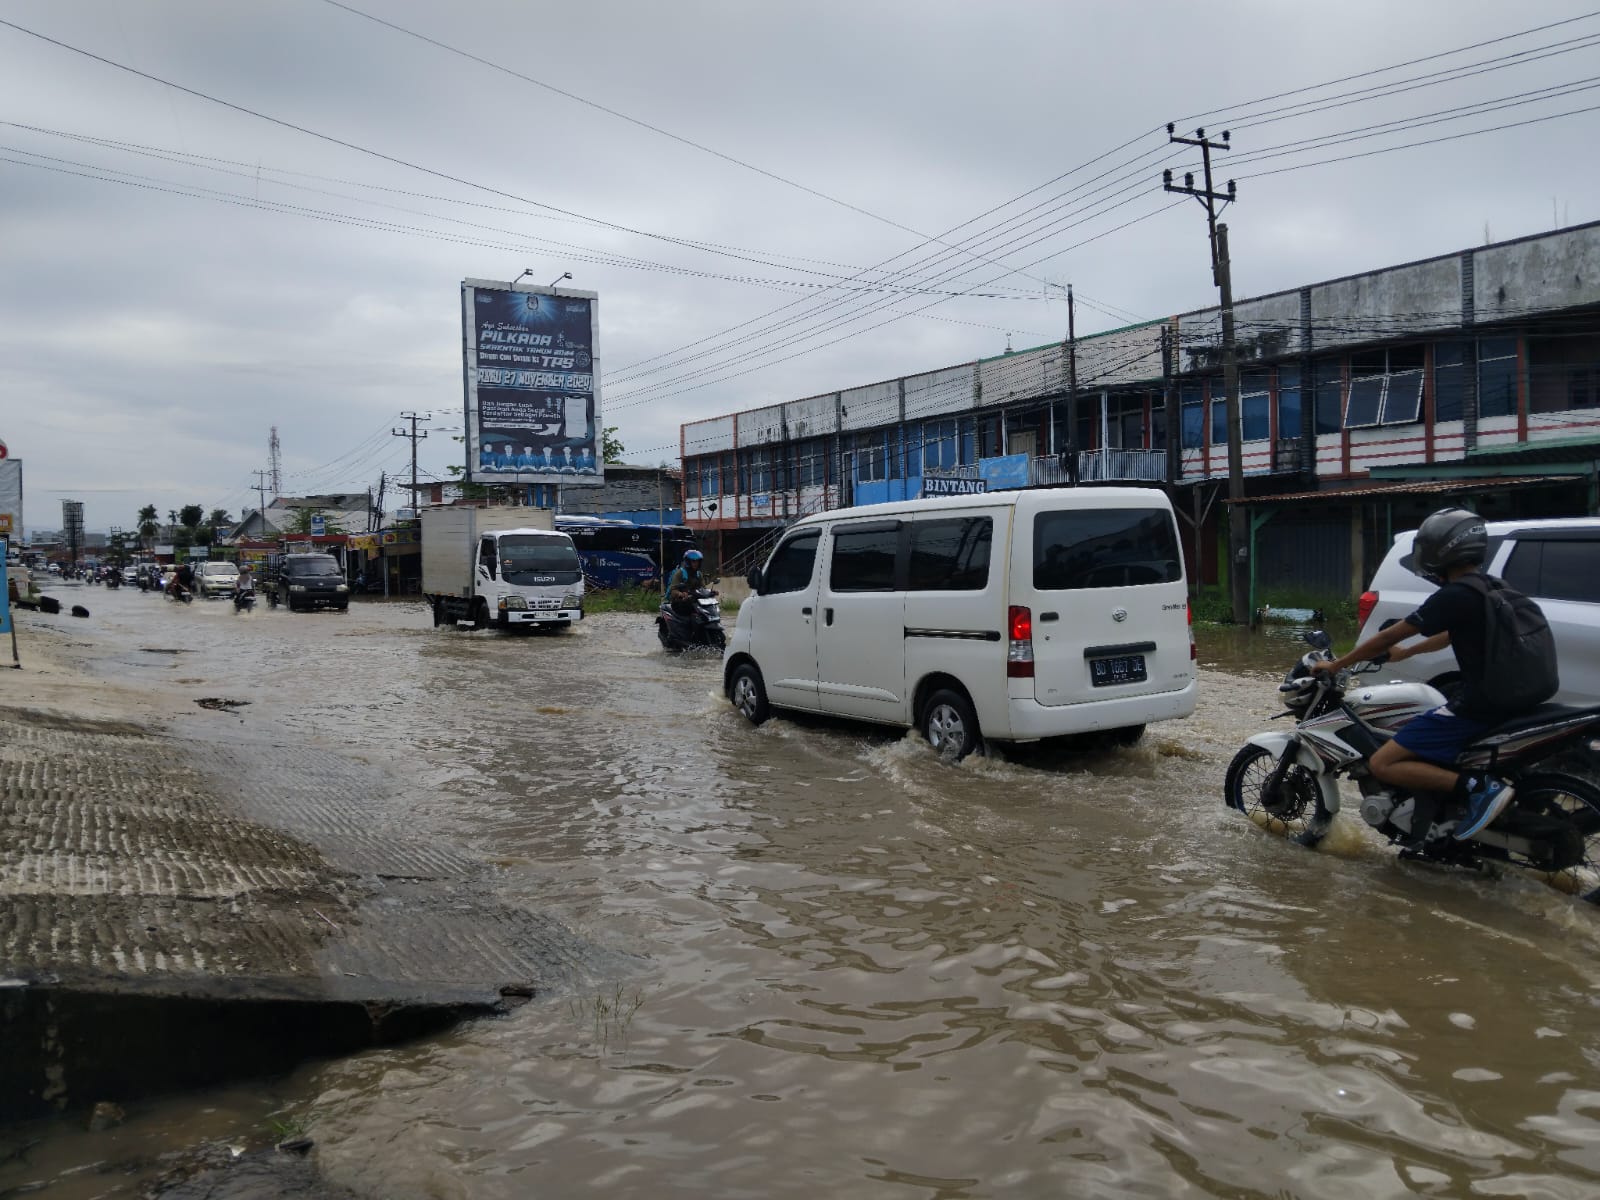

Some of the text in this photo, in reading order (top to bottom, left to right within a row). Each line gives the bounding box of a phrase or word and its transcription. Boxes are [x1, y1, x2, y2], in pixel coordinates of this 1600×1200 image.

[480, 329, 553, 347] PILKADA
[479, 343, 523, 353] SERENTAK
[540, 355, 575, 369] TPS
[504, 371, 517, 386] 27
[518, 371, 566, 389] NOVEMBER
[924, 478, 985, 494] BINTANG
